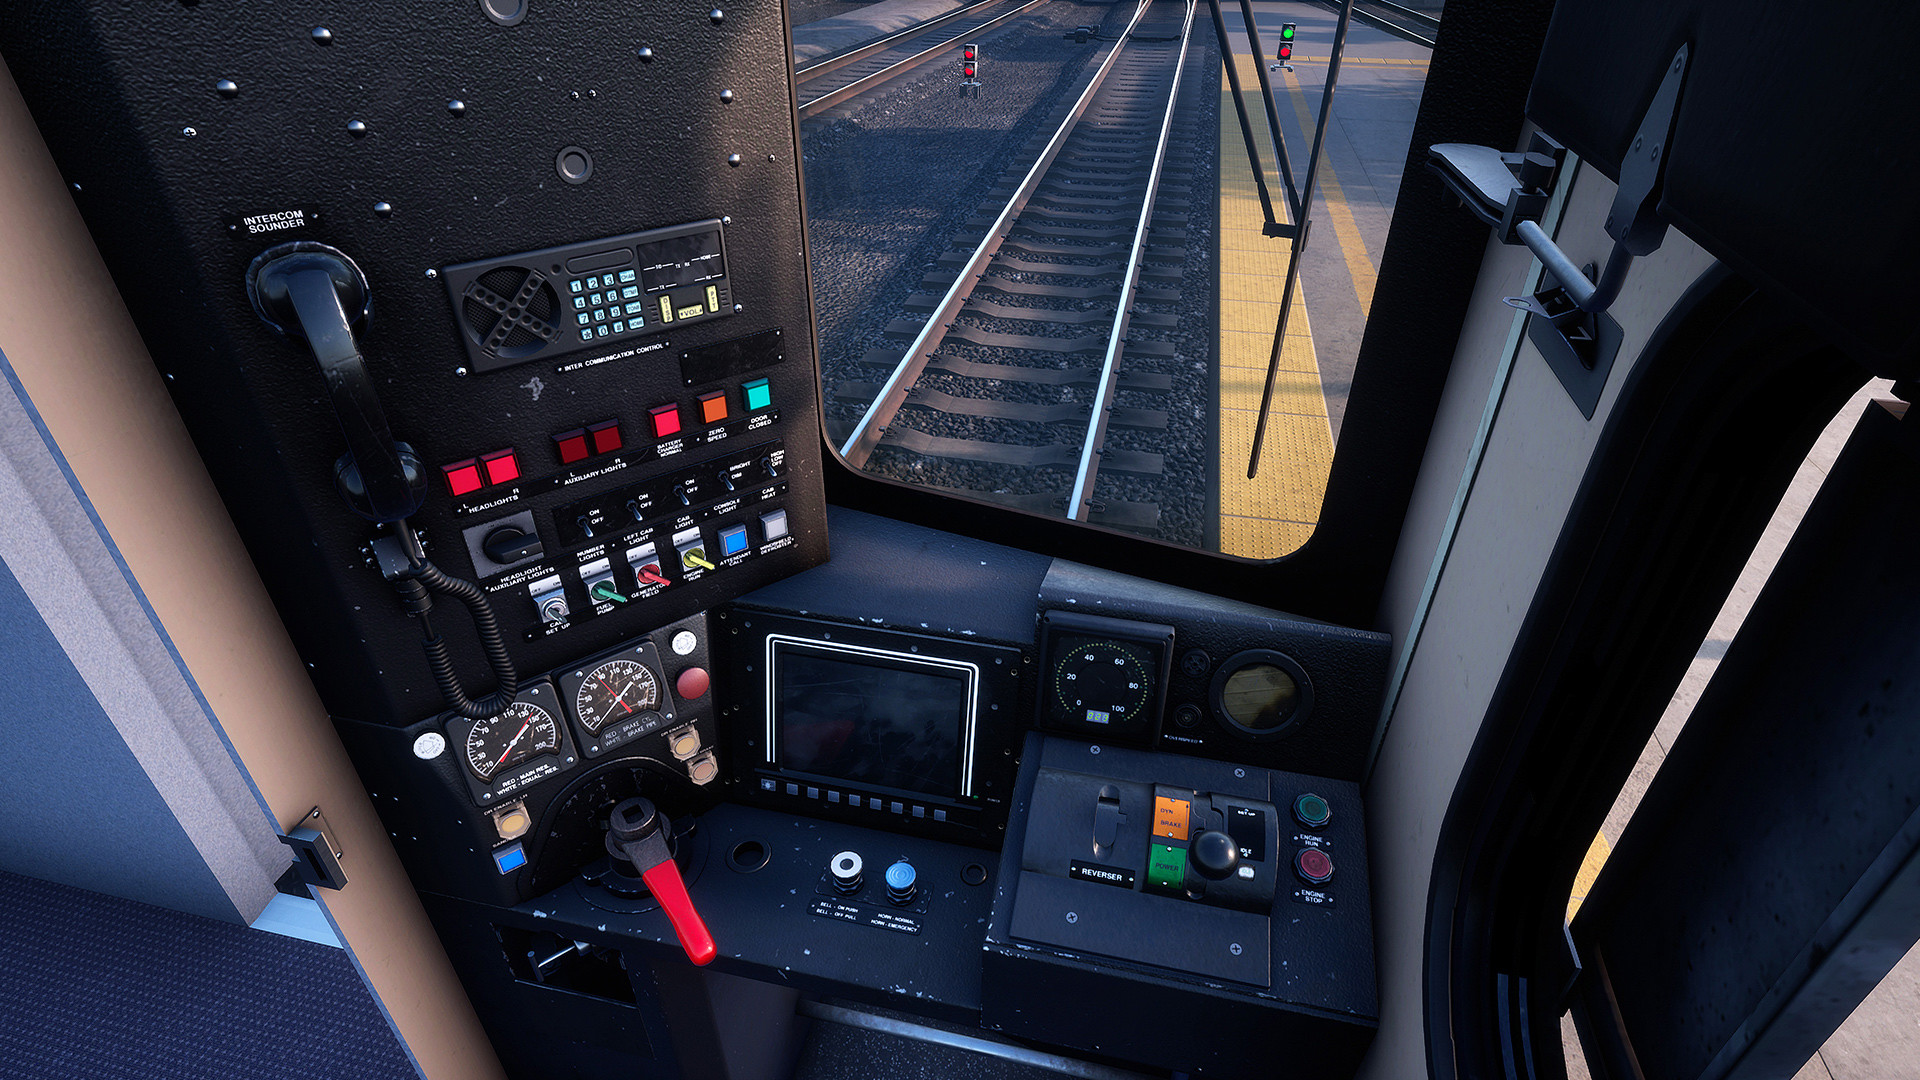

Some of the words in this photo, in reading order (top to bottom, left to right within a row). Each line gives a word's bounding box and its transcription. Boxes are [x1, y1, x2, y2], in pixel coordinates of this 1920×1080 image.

[244, 209, 304, 226] INTERCOM
[248, 218, 305, 234] SOUNDER
[590, 280, 597, 288] 2
[606, 276, 613, 285] 3
[593, 296, 600, 305] 5
[609, 292, 616, 301] 6
[577, 299, 584, 307] 4
[612, 308, 619, 316] 9
[663, 297, 671, 321] DISP
[683, 308, 699, 317] VOL
[580, 315, 587, 323] 7
[597, 312, 604, 320] 8
[600, 327, 607, 336] 0
[564, 362, 583, 372] INTER
[584, 350, 635, 367] COMMUNICATION
[636, 343, 664, 354] CONTROL
[750, 414, 768, 424] DOOR
[747, 419, 772, 431] CLOSED
[708, 427, 725, 437] ZERO
[706, 432, 728, 443] SPEED
[656, 439, 682, 450] BATTERY
[660, 448, 682, 458] NORMAL
[729, 460, 751, 472] BRIGHT
[564, 470, 600, 486] AUXILIARY
[600, 462, 628, 475] LIGHTS
[685, 478, 695, 486] ON
[686, 486, 699, 494] OFF
[761, 486, 775, 495] CAB
[638, 493, 649, 501] ON
[761, 491, 776, 500] HEAT
[468, 494, 519, 514] HEADLIGHTS
[640, 501, 652, 509] OFF
[713, 498, 740, 511] CONSOLE
[718, 504, 737, 515] LIGHT
[591, 516, 604, 525] OFF
[676, 515, 691, 523] CAB
[674, 519, 695, 530] LIGHT
[623, 532, 639, 542] LEFT
[639, 527, 654, 536] CAB
[628, 534, 650, 545] LIGHT
[576, 544, 605, 558] NUMBER
[578, 549, 605, 562] LIGHTS
[719, 550, 751, 566] ATTENDANT
[728, 558, 743, 567] CALL
[500, 564, 543, 583] HEADLIGHT
[683, 568, 705, 579] ENGINE
[688, 574, 701, 582] RUN
[490, 576, 526, 593] AUXILIARY
[527, 566, 555, 580] LIGHTS
[631, 583, 666, 599] GENERATO
[641, 589, 660, 600] FIELD
[596, 602, 612, 612] FUEL
[597, 605, 615, 616] PUMP
[545, 627, 559, 636] SET
[561, 622, 571, 630] UP
[549, 620, 564, 629] CA
[1084, 654, 1095, 662] 40
[1114, 658, 1125, 666] 60
[609, 667, 620, 675] 110
[622, 667, 633, 676] 130
[631, 673, 643, 681] 150
[1066, 672, 1077, 681] 20
[588, 682, 598, 690] 70
[638, 681, 649, 690] 170
[1128, 682, 1139, 690] 80
[584, 695, 593, 703] 50
[585, 706, 594, 715] 30
[1111, 704, 1125, 713] 100
[502, 709, 515, 719] 110
[517, 709, 530, 719] 130
[489, 716, 499, 725] 90
[528, 715, 540, 724] 150
[592, 715, 601, 723] 10
[481, 726, 490, 735] 70
[535, 724, 547, 733] 170
[605, 730, 617, 740] RED
[622, 720, 640, 732] BRAKE
[604, 736, 622, 748] WHITE
[627, 725, 645, 738] BRAKE
[645, 720, 657, 729] PIPE
[476, 739, 485, 748] 50
[534, 741, 547, 751] 200
[477, 752, 487, 760] 30
[485, 760, 494, 769] 10
[502, 778, 516, 788] RED
[519, 769, 536, 780] MAIN
[496, 783, 517, 796] WHITE
[493, 798, 517, 813] ENABLE
[1160, 807, 1174, 815] DYN
[1160, 819, 1182, 829] BRAKE
[1299, 833, 1323, 843] ENGINE
[1304, 839, 1319, 848] RUN
[1155, 862, 1179, 872] POWER
[1081, 867, 1123, 882] REVERSER
[1301, 889, 1325, 899] ENGINE
[1305, 895, 1323, 905] STOP
[844, 913, 857, 921] PULL
